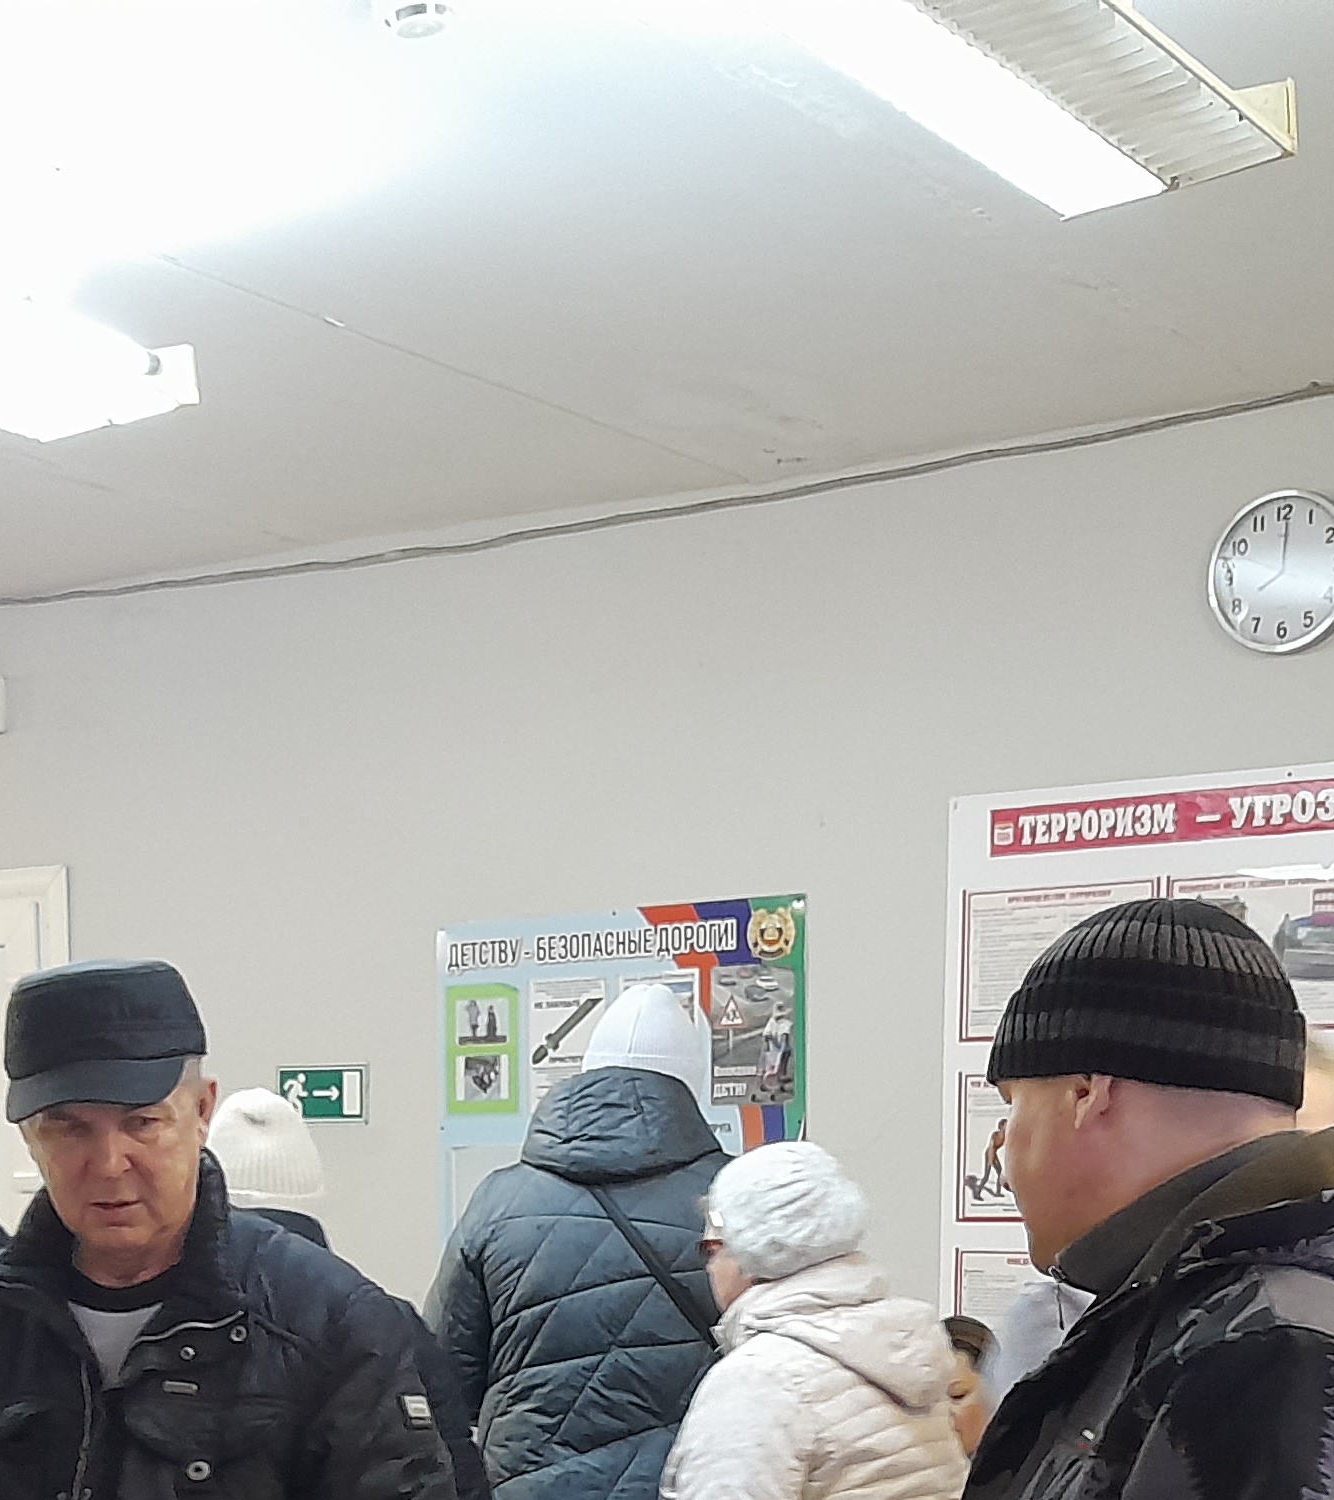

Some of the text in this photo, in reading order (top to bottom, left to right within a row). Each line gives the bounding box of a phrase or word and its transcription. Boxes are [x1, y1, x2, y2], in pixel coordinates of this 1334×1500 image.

[1276, 503, 1293, 521] 12
[1307, 508, 1314, 525] 1
[1252, 515, 1266, 533] 11
[1231, 538, 1249, 556] 10
[1322, 586, 1334, 604] 4
[1231, 598, 1242, 615] 8
[1251, 616, 1261, 634] 7
[1303, 610, 1314, 628] 5
[1276, 621, 1288, 639] 6
[1017, 802, 1176, 847] ТЕРРОРИЗМ
[446, 939, 521, 974] ДЕТСТВУ
[535, 927, 654, 963] БЕЗОПАСНЫЕ
[656, 918, 738, 956] ДОРОГИ!
